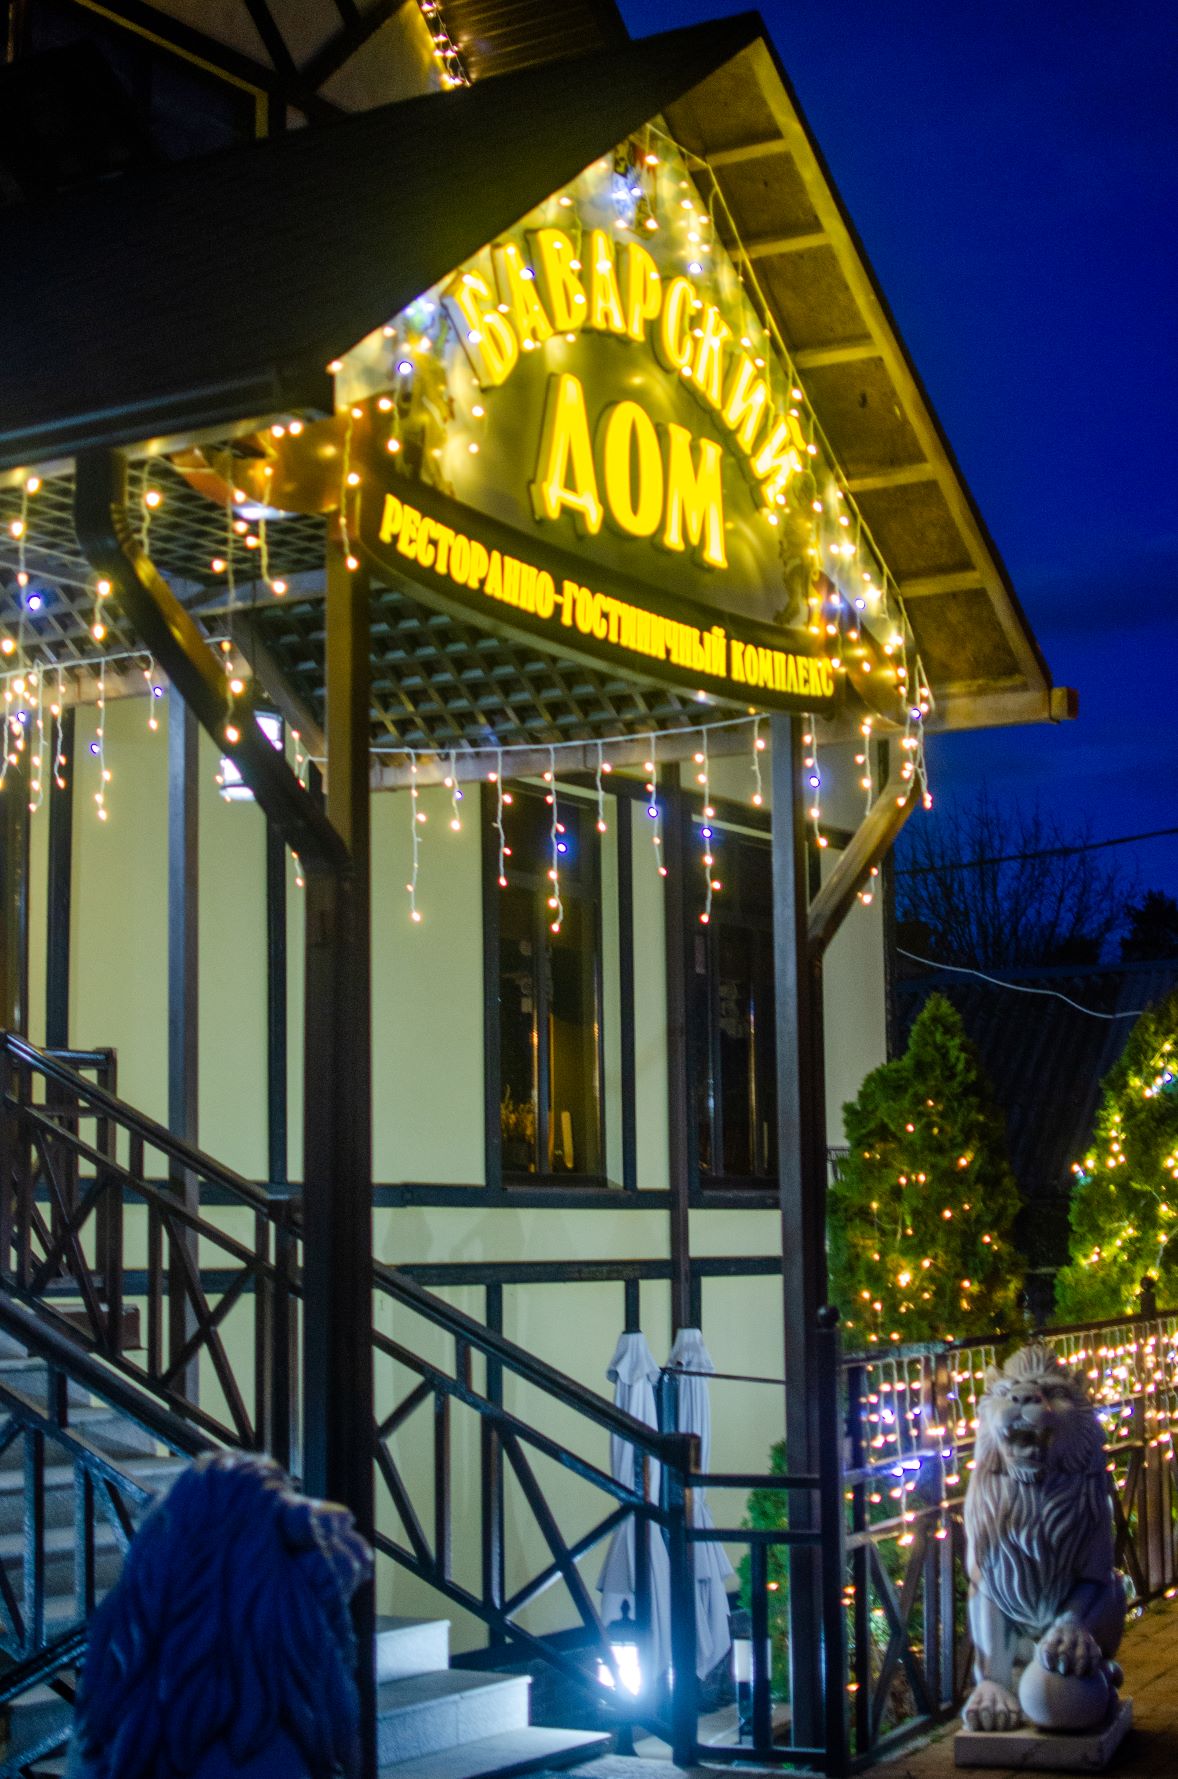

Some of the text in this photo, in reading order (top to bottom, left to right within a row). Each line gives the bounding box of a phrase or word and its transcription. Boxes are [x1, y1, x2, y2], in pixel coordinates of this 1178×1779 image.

[445, 228, 806, 508] БАВАРСКИЙ
[538, 373, 728, 569] ДОМ
[379, 493, 834, 697] РЕСТОРАННО-ГОСТИНИЧНЫЙ КОМПЛЕКС
